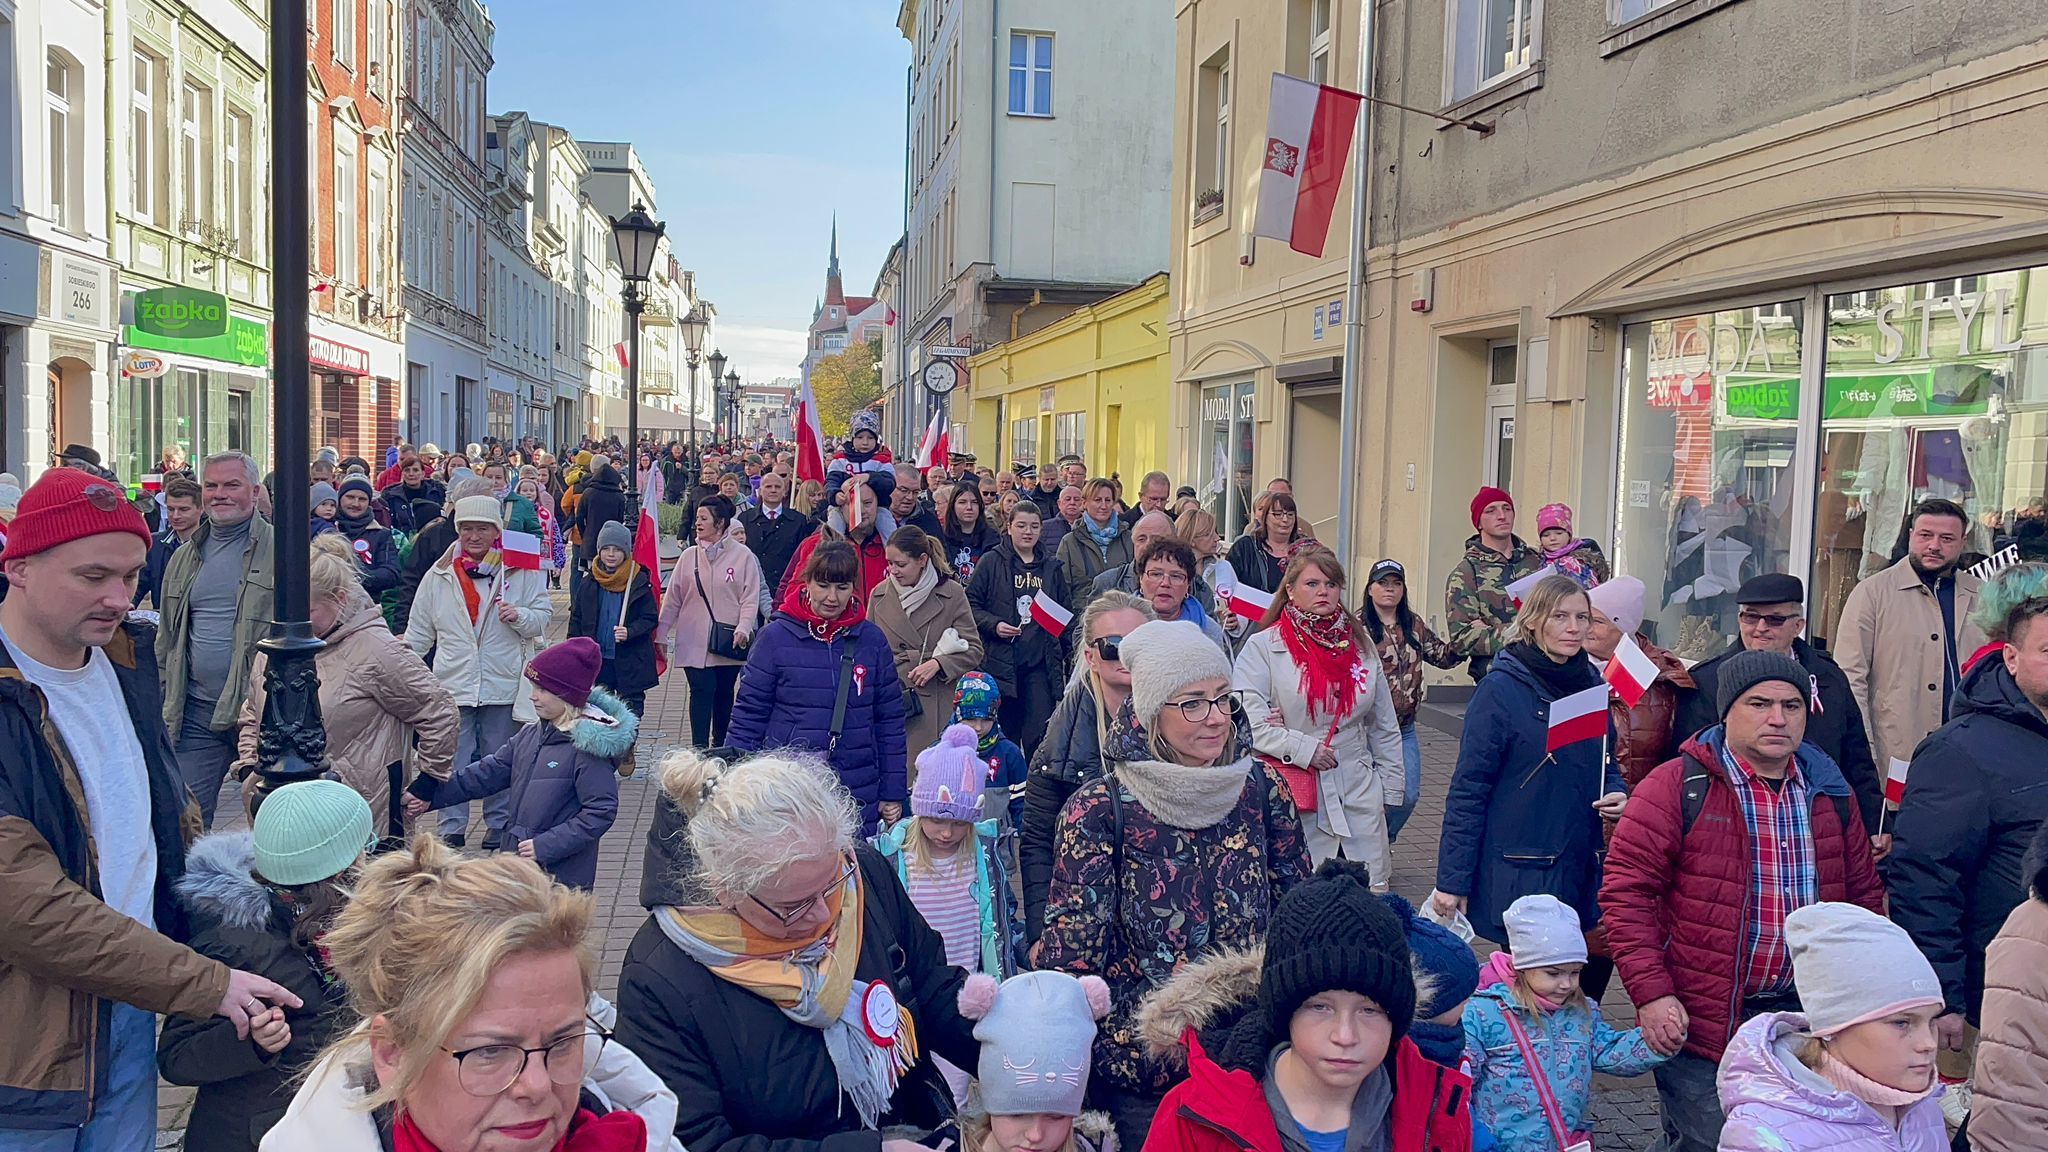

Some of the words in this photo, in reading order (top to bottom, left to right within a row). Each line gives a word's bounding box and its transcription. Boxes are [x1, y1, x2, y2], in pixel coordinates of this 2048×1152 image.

[72, 290, 91, 310] 266
[141, 298, 220, 321] żabka
[1874, 289, 2024, 364] STYL
[236, 324, 265, 355] żabka
[1646, 319, 1772, 381] MODA
[134, 360, 156, 370] LOTTO
[329, 343, 343, 365] DLA
[1204, 398, 1230, 421] MODA
